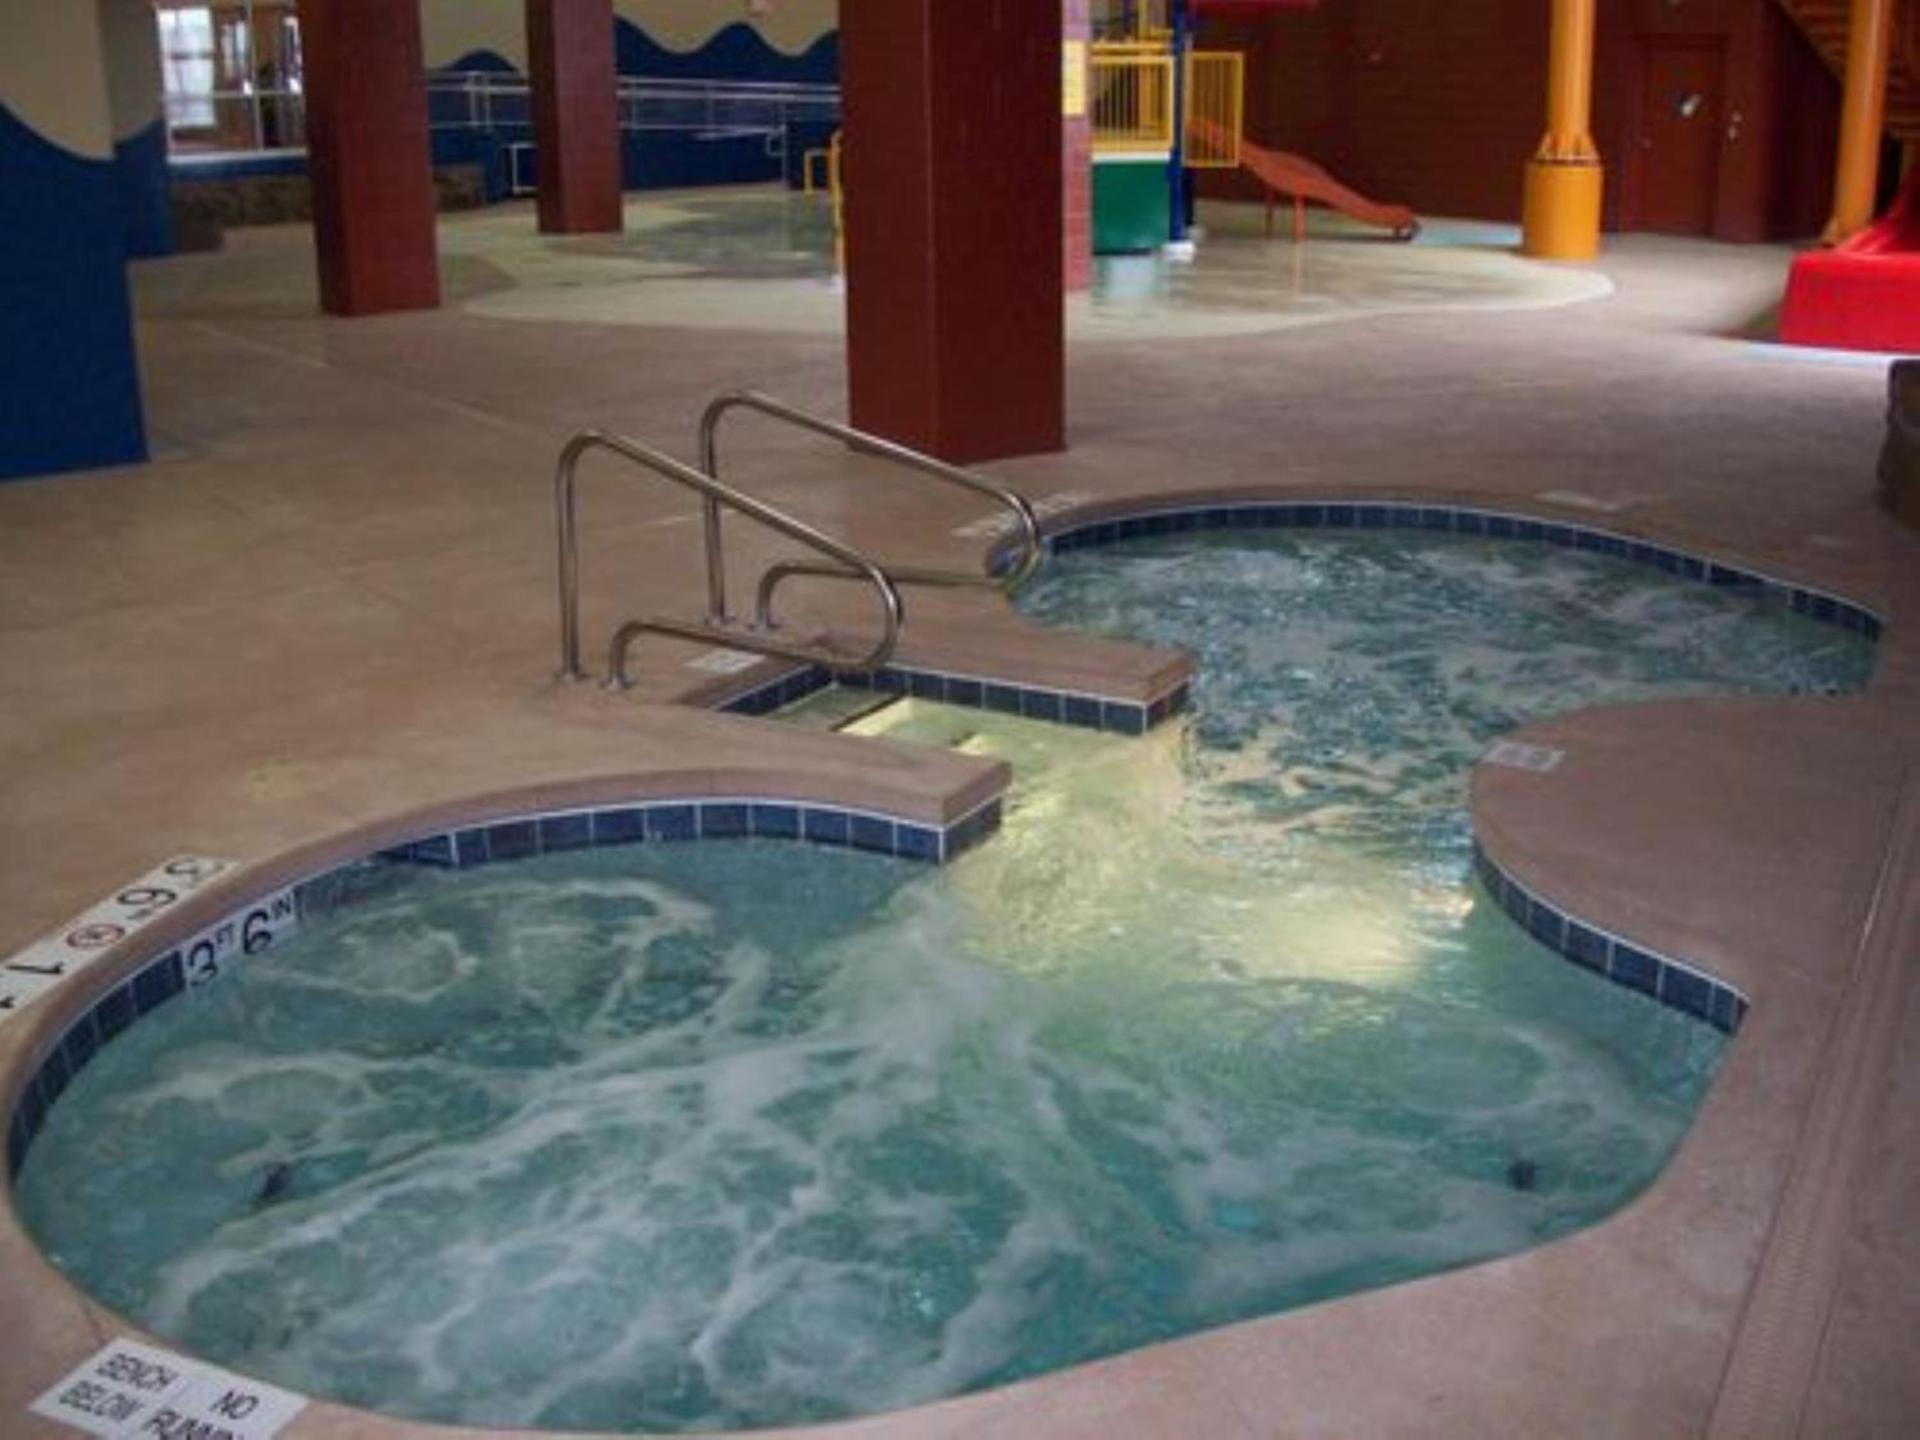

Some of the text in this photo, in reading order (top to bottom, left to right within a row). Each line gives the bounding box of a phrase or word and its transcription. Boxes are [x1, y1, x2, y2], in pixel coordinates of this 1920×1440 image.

[243, 909, 273, 955] 6
[96, 1352, 178, 1391] BENCH
[59, 1379, 143, 1421] BELOW
[209, 1389, 259, 1420] NO
